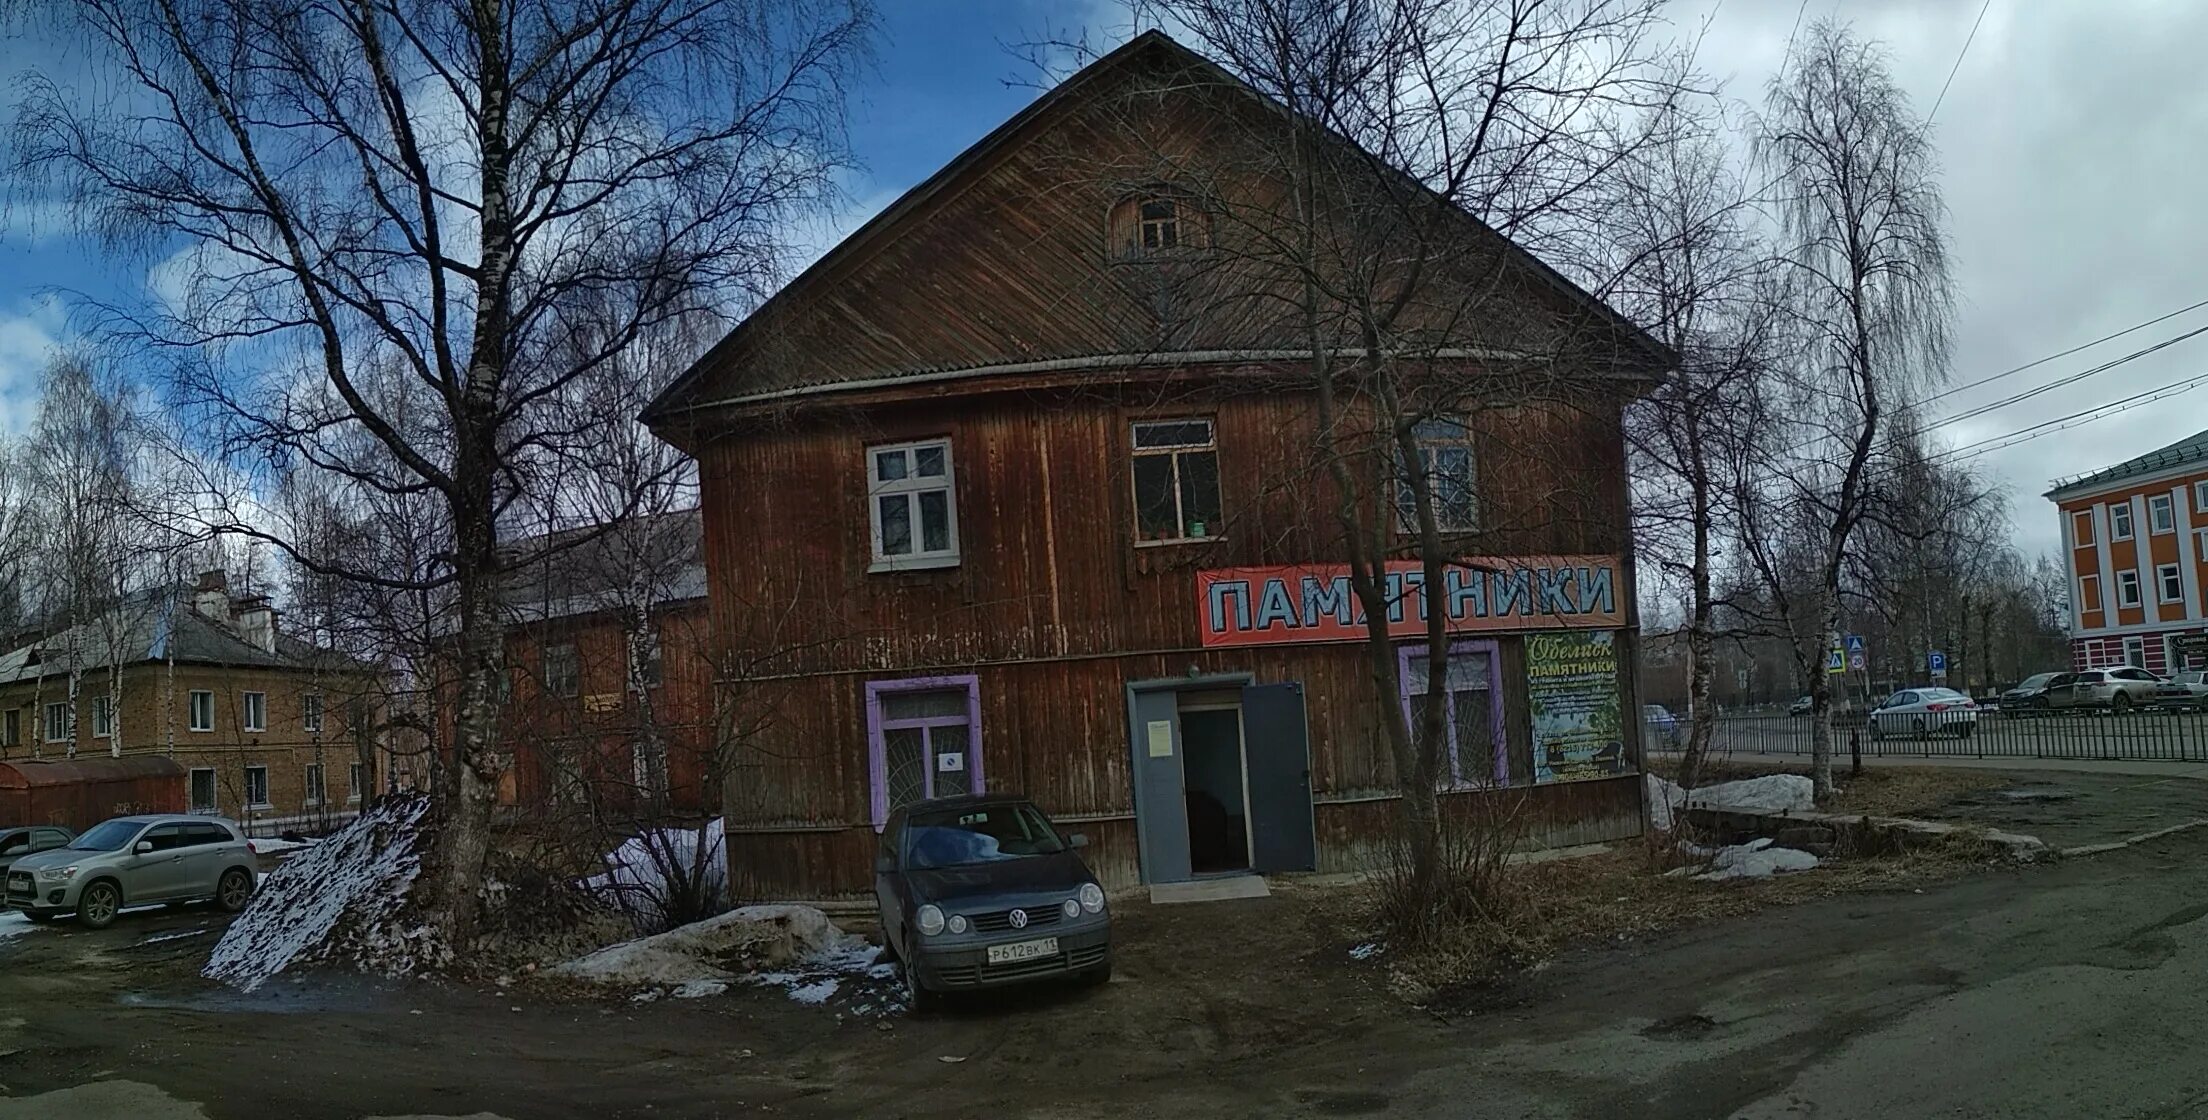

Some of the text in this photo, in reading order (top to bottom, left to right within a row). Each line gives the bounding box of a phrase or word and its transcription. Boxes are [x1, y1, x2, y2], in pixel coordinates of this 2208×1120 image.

[1209, 567, 1615, 632] ПАМЯТНИКИ
[1530, 635, 1613, 661] Обелиск
[1530, 660, 1616, 677] ПАМЯТНИКИ
